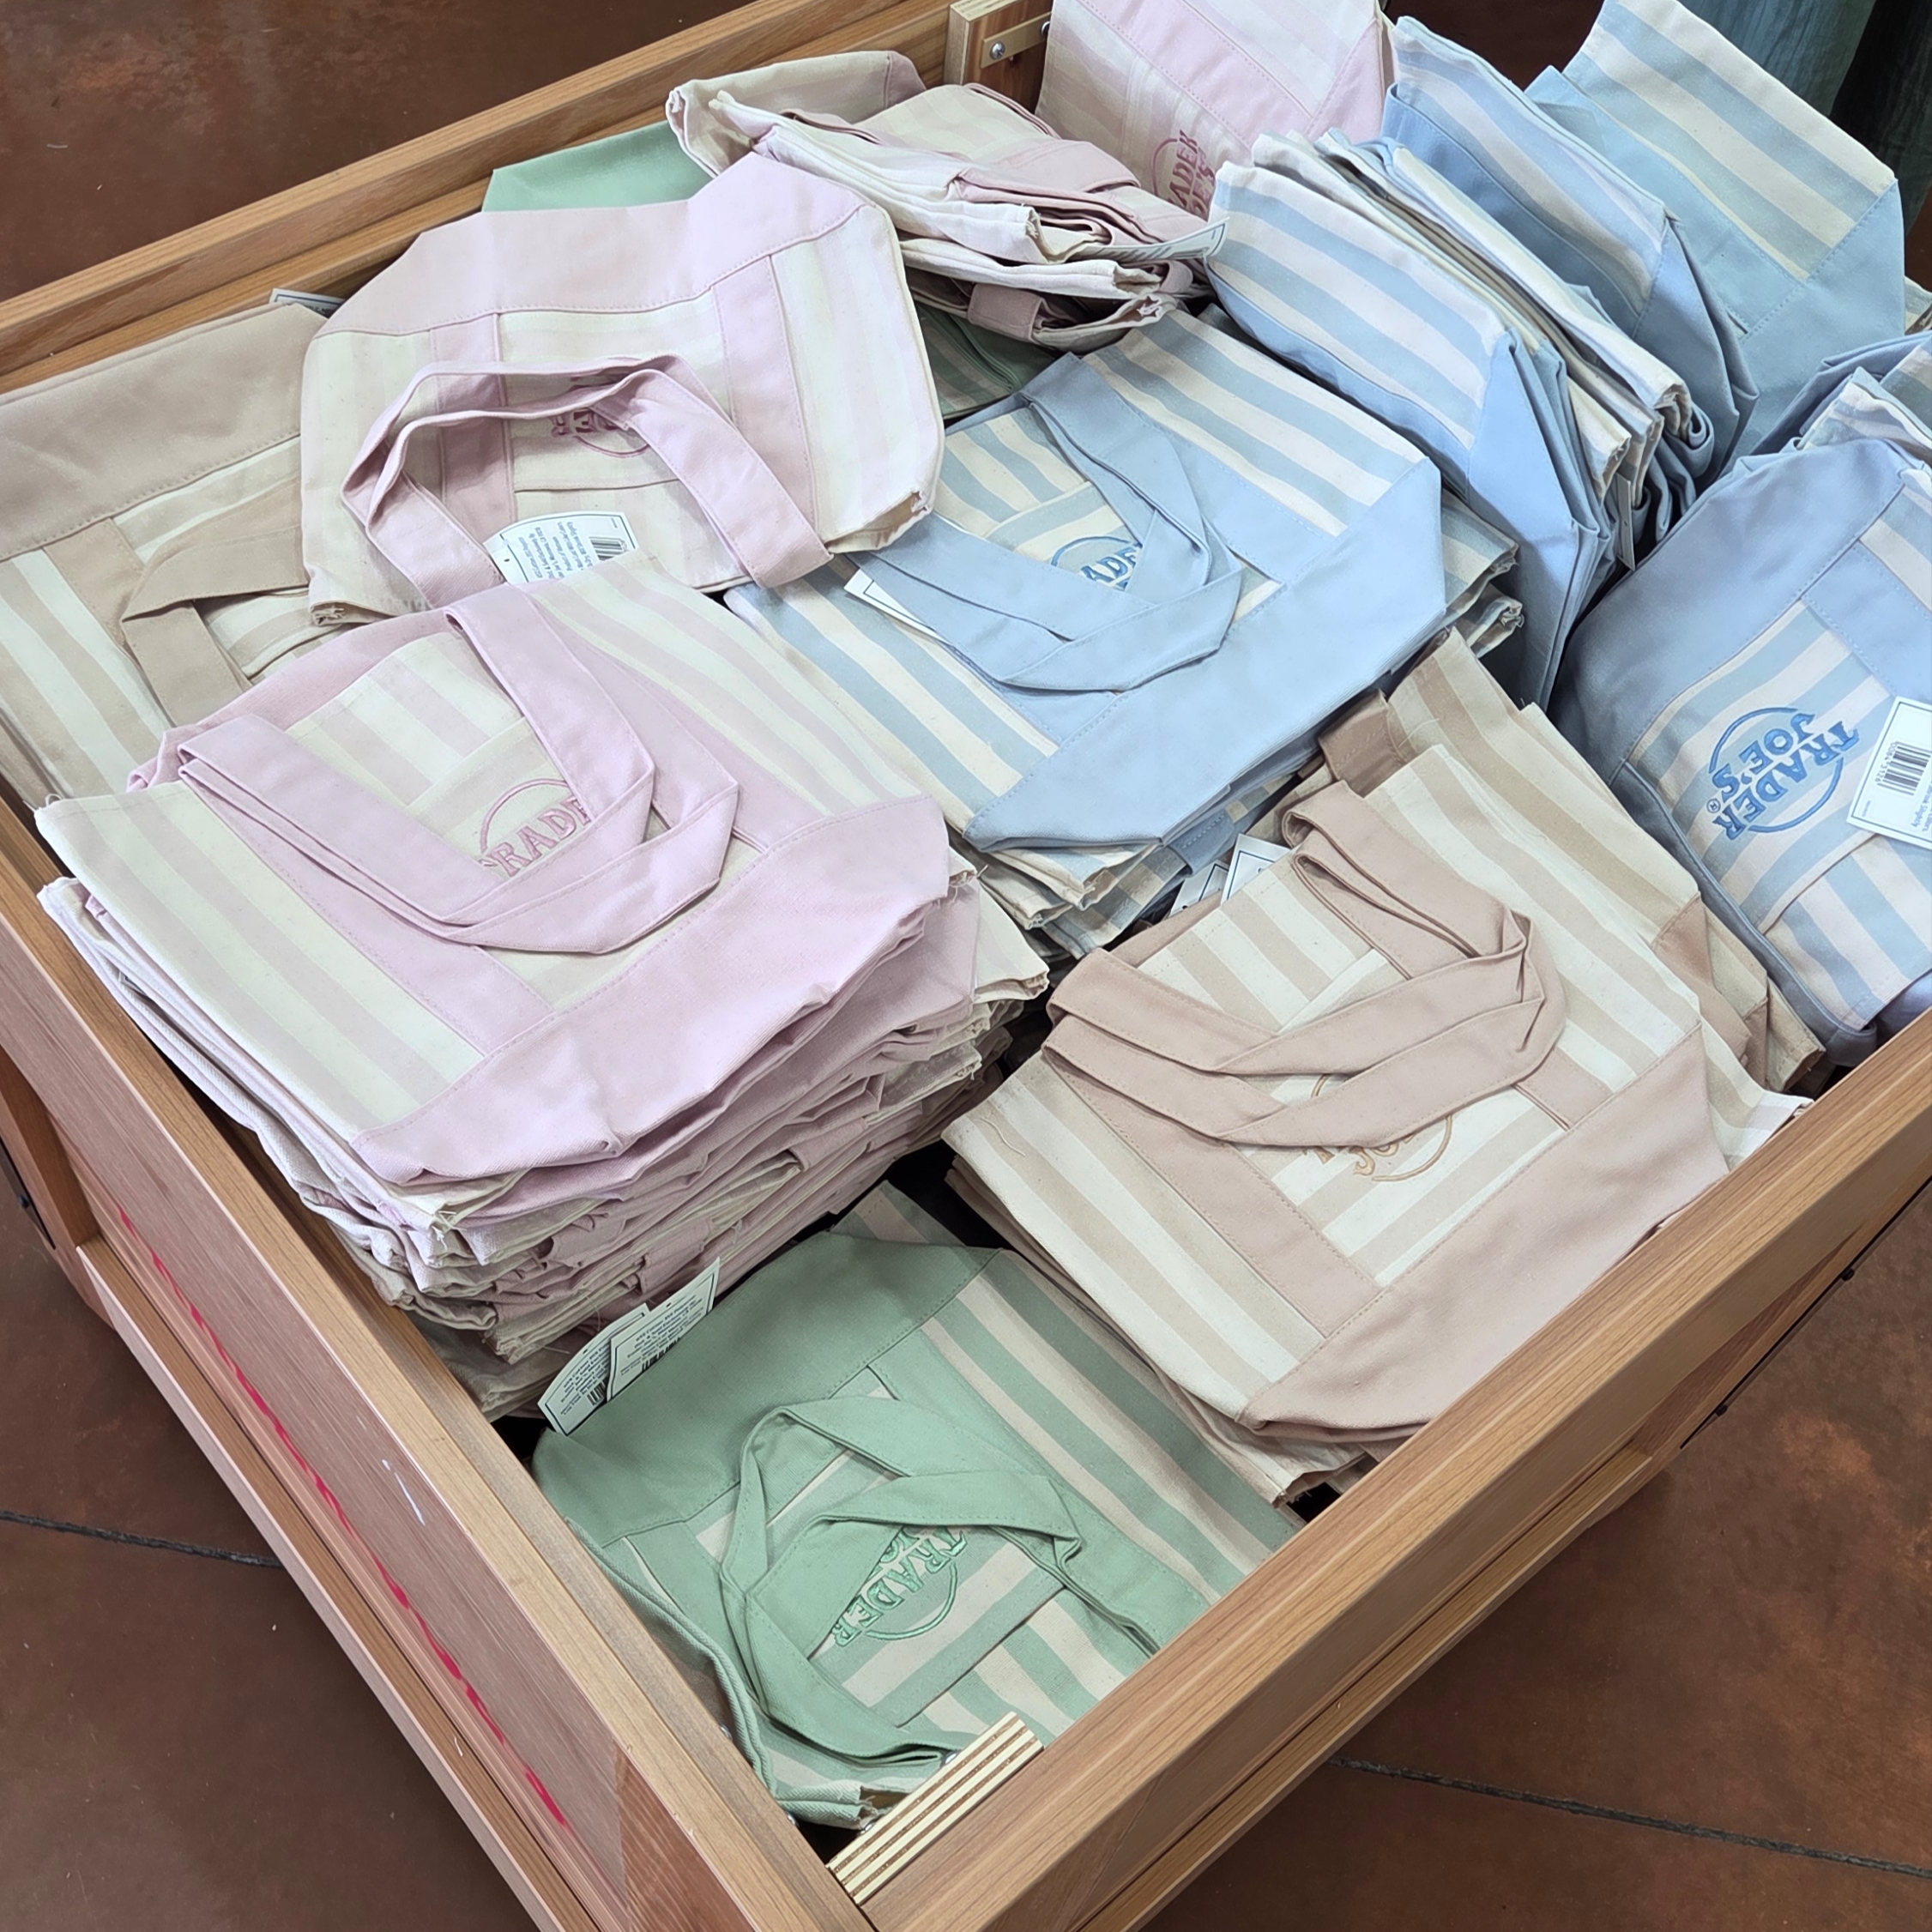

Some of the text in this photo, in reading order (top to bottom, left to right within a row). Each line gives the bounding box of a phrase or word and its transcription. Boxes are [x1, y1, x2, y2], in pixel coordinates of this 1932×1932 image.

[1168, 129, 1198, 209] ADER
[1712, 713, 1815, 803] JOE'S
[1714, 721, 1860, 840] TRADER
[478, 794, 592, 878] RADE
